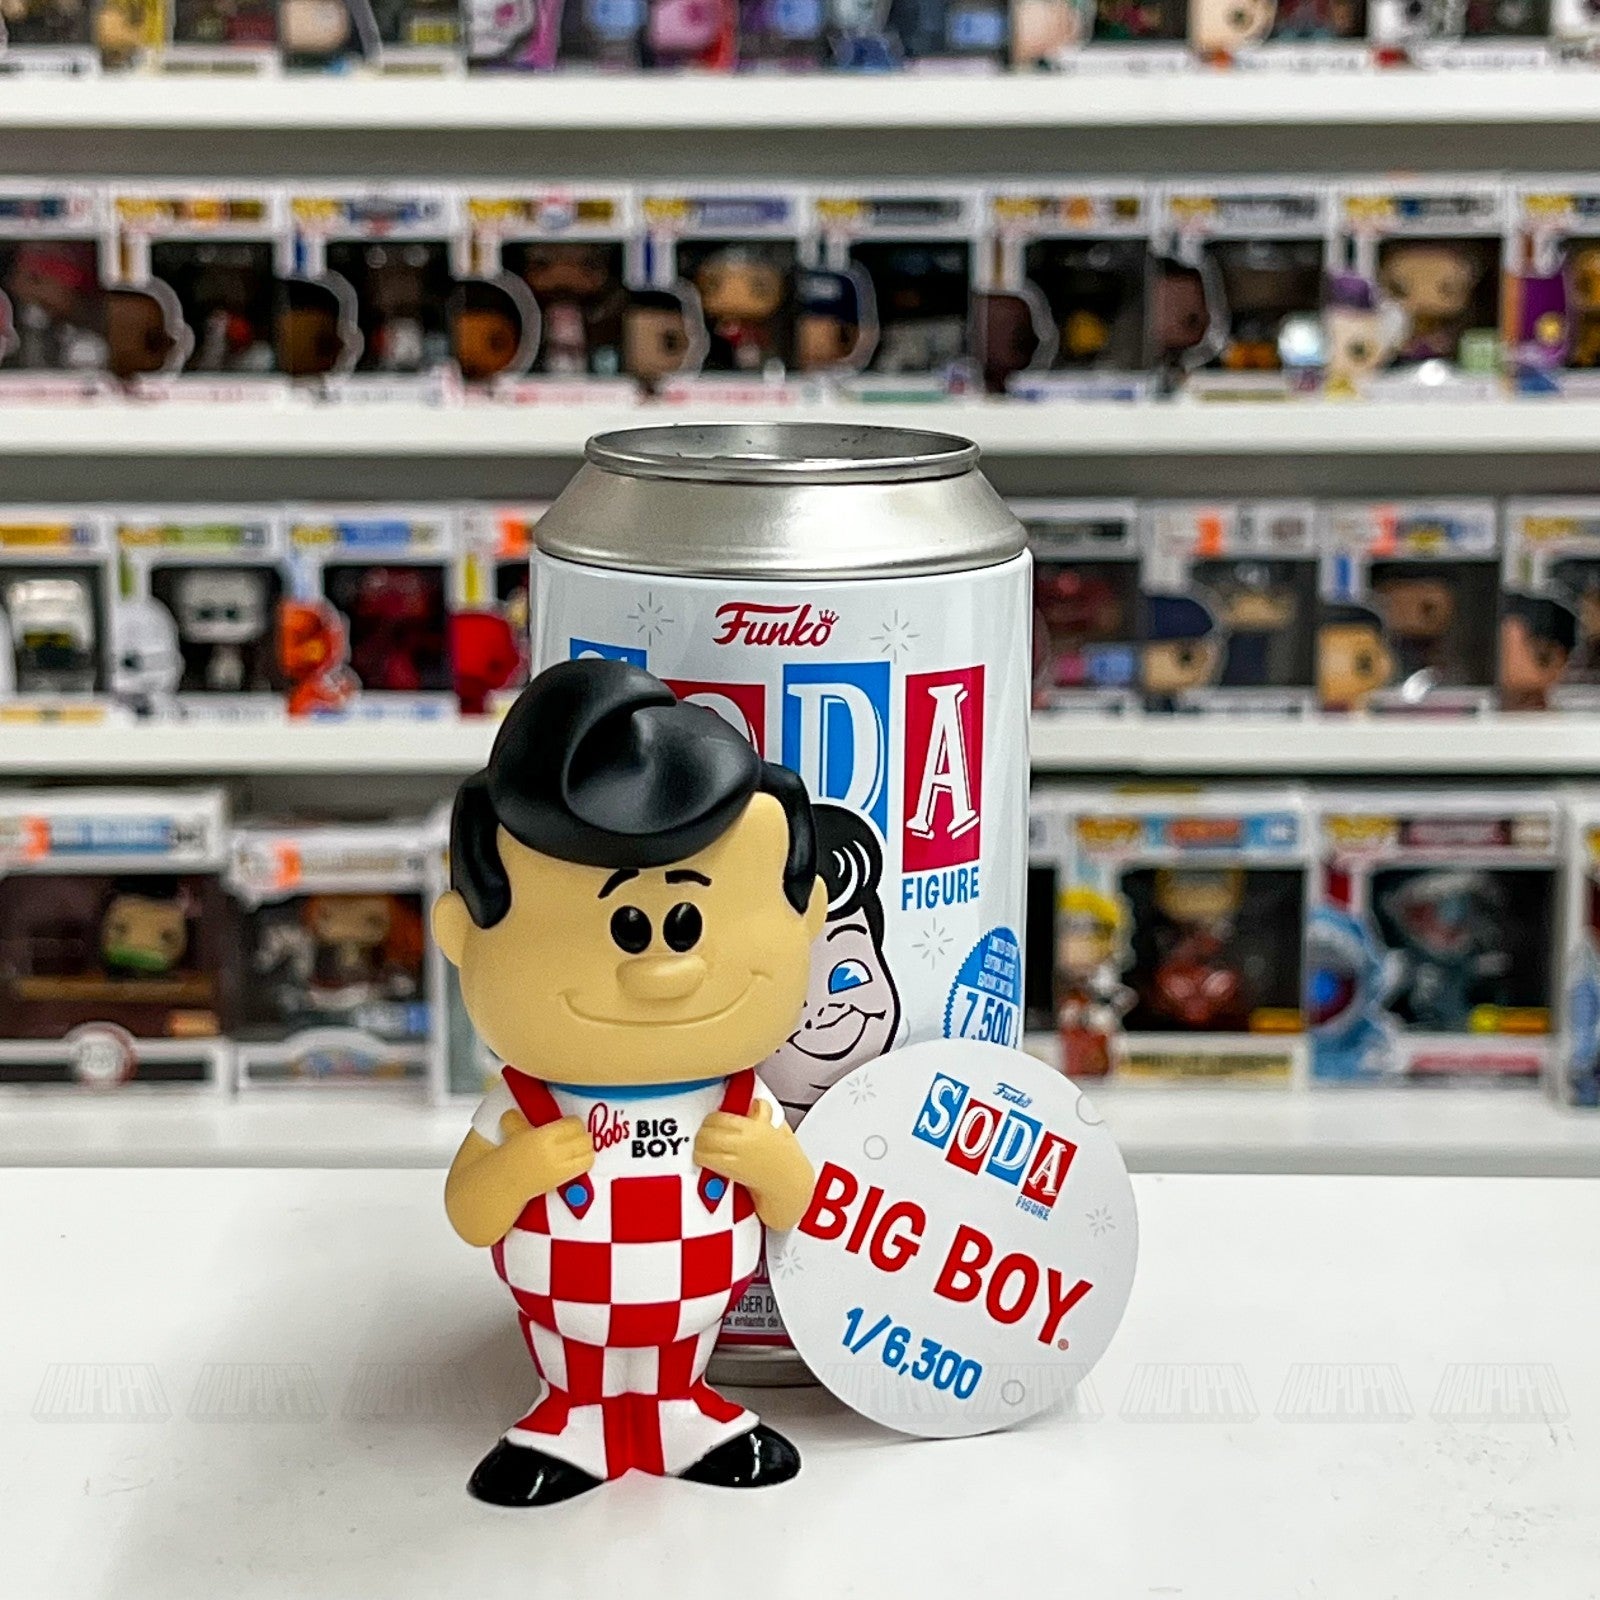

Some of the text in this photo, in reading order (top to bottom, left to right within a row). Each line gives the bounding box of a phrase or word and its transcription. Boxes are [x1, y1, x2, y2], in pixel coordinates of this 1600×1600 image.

[712, 601, 836, 647] Funko
[901, 866, 980, 911] FIGURE
[992, 1081, 1033, 1109] Funko
[587, 1101, 679, 1153] Bob's BIG
[914, 1074, 1074, 1202] SODA
[797, 1160, 927, 1274] BIG
[841, 1306, 983, 1400] 1/6,300
